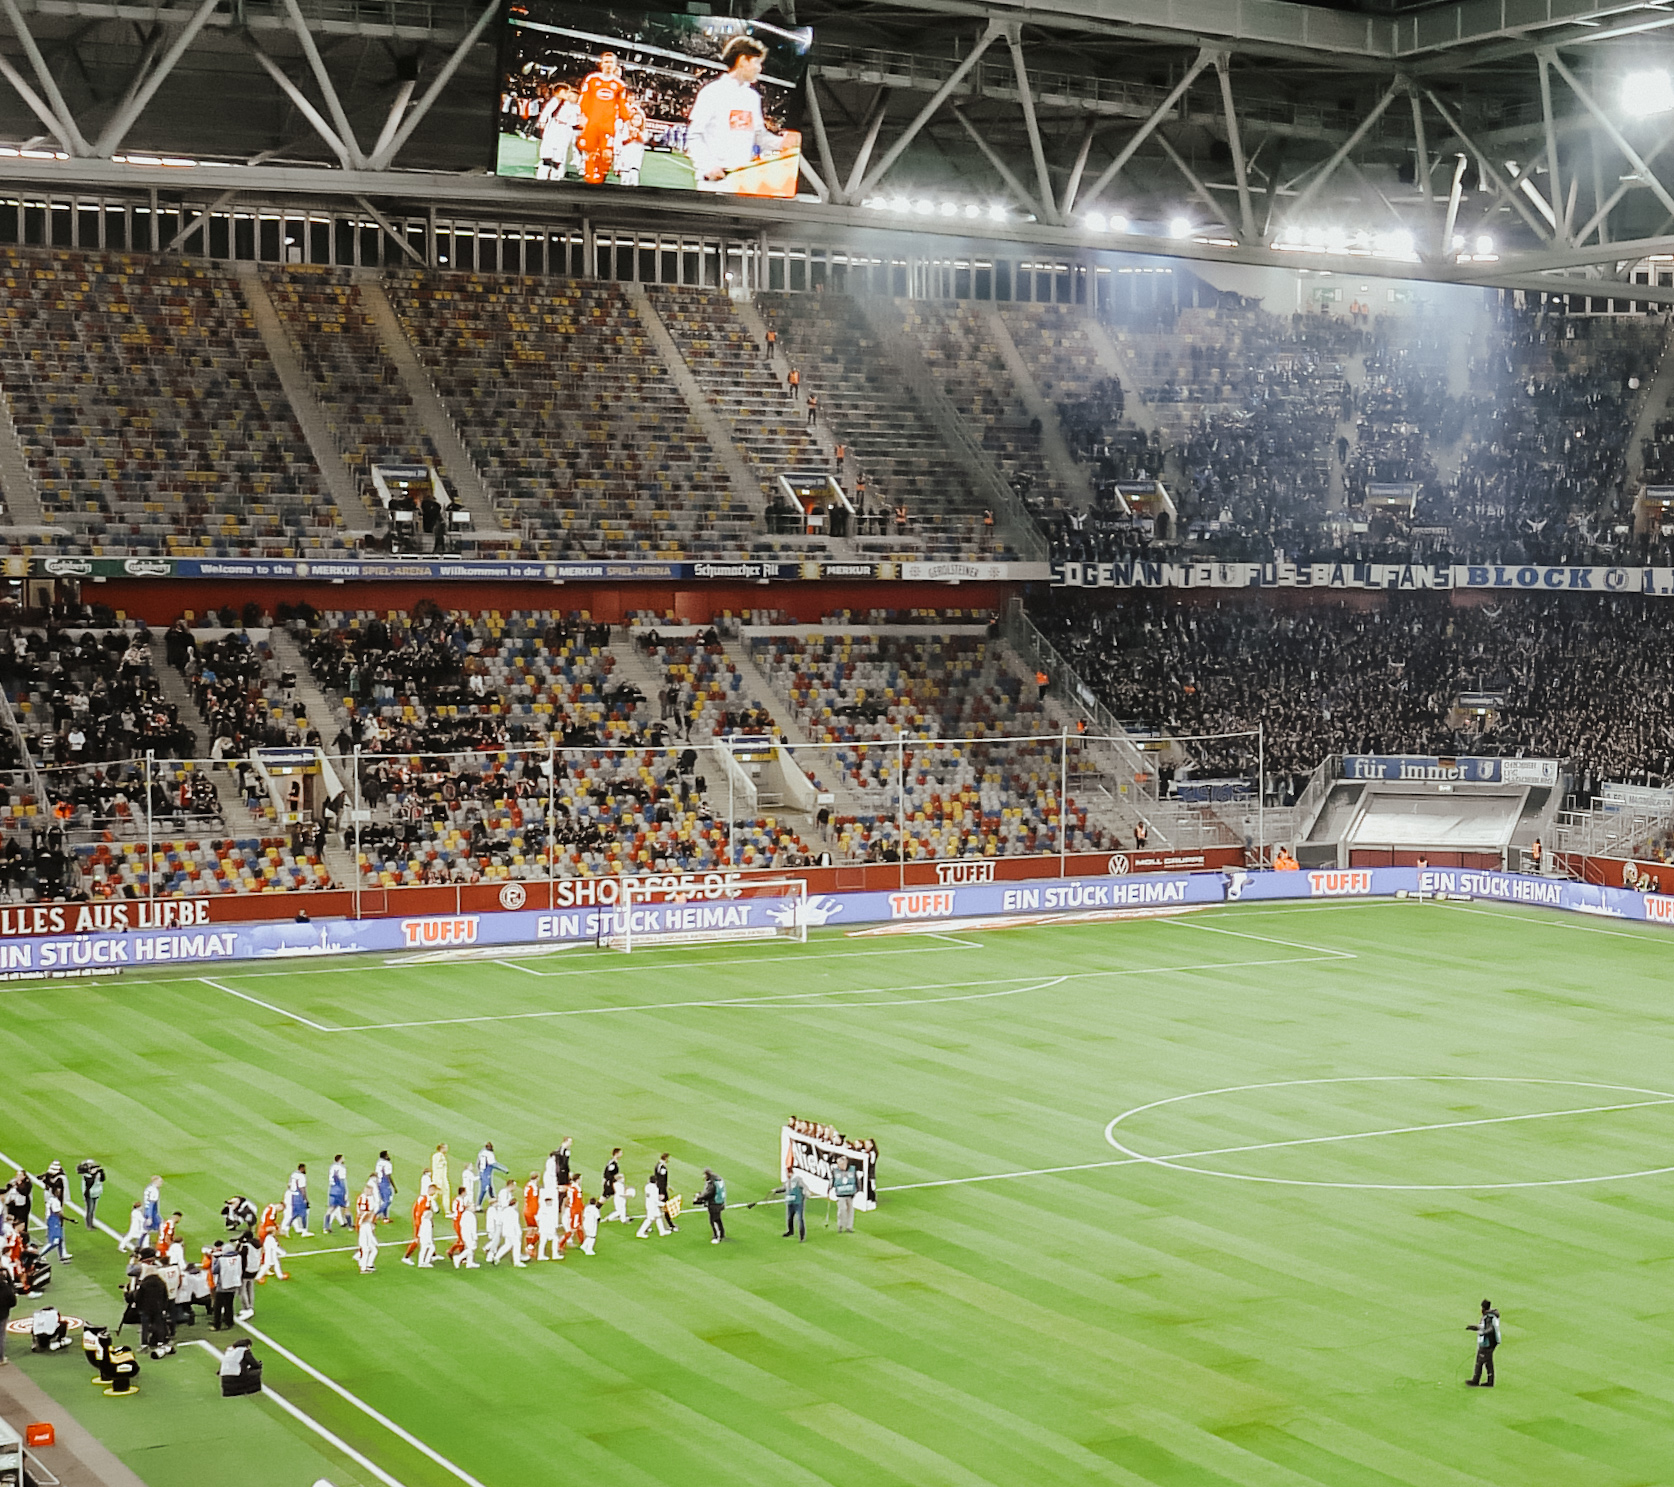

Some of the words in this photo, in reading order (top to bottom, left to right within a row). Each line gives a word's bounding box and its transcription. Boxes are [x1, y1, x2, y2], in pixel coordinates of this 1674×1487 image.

[45, 559, 92, 575] Carlsberg
[124, 559, 171, 575] Carlsberg
[200, 564, 253, 575] Welcome
[256, 565, 269, 575] to
[273, 564, 293, 575] the
[311, 565, 359, 576] MERKUR
[362, 566, 432, 576] SPIEL-ARENA
[440, 565, 509, 576] Willkommen
[510, 565, 520, 576] in
[522, 566, 541, 577] der
[559, 567, 603, 577] MERKUR
[606, 567, 671, 577] SPIEL-ARENA
[694, 563, 760, 578] Schumacher
[826, 565, 871, 576] MERKUR
[1050, 562, 1211, 587] SOGENANNTE
[1467, 567, 1593, 588] BLOCK
[1354, 758, 1387, 779] für
[1399, 760, 1468, 781] immer
[937, 862, 996, 885] TUFFI
[1307, 869, 1373, 895] TUFFI
[1003, 888, 1039, 910] EIN
[1044, 882, 1109, 908] STÜCK
[1113, 881, 1189, 904] HEIMAT
[1421, 871, 1455, 891] EIN
[1460, 871, 1510, 897] STÜCK
[1512, 879, 1563, 904] HEIMAT
[889, 890, 955, 917] TUFFI
[75, 903, 130, 933] AUS
[138, 900, 210, 928] LIEBE
[537, 915, 579, 938] EIN
[586, 905, 660, 935] STÜCK
[666, 905, 752, 929] HEIMAT
[403, 915, 479, 946] TUFFI
[40, 935, 128, 967] STÜCK
[135, 933, 238, 961] HEIMAT
